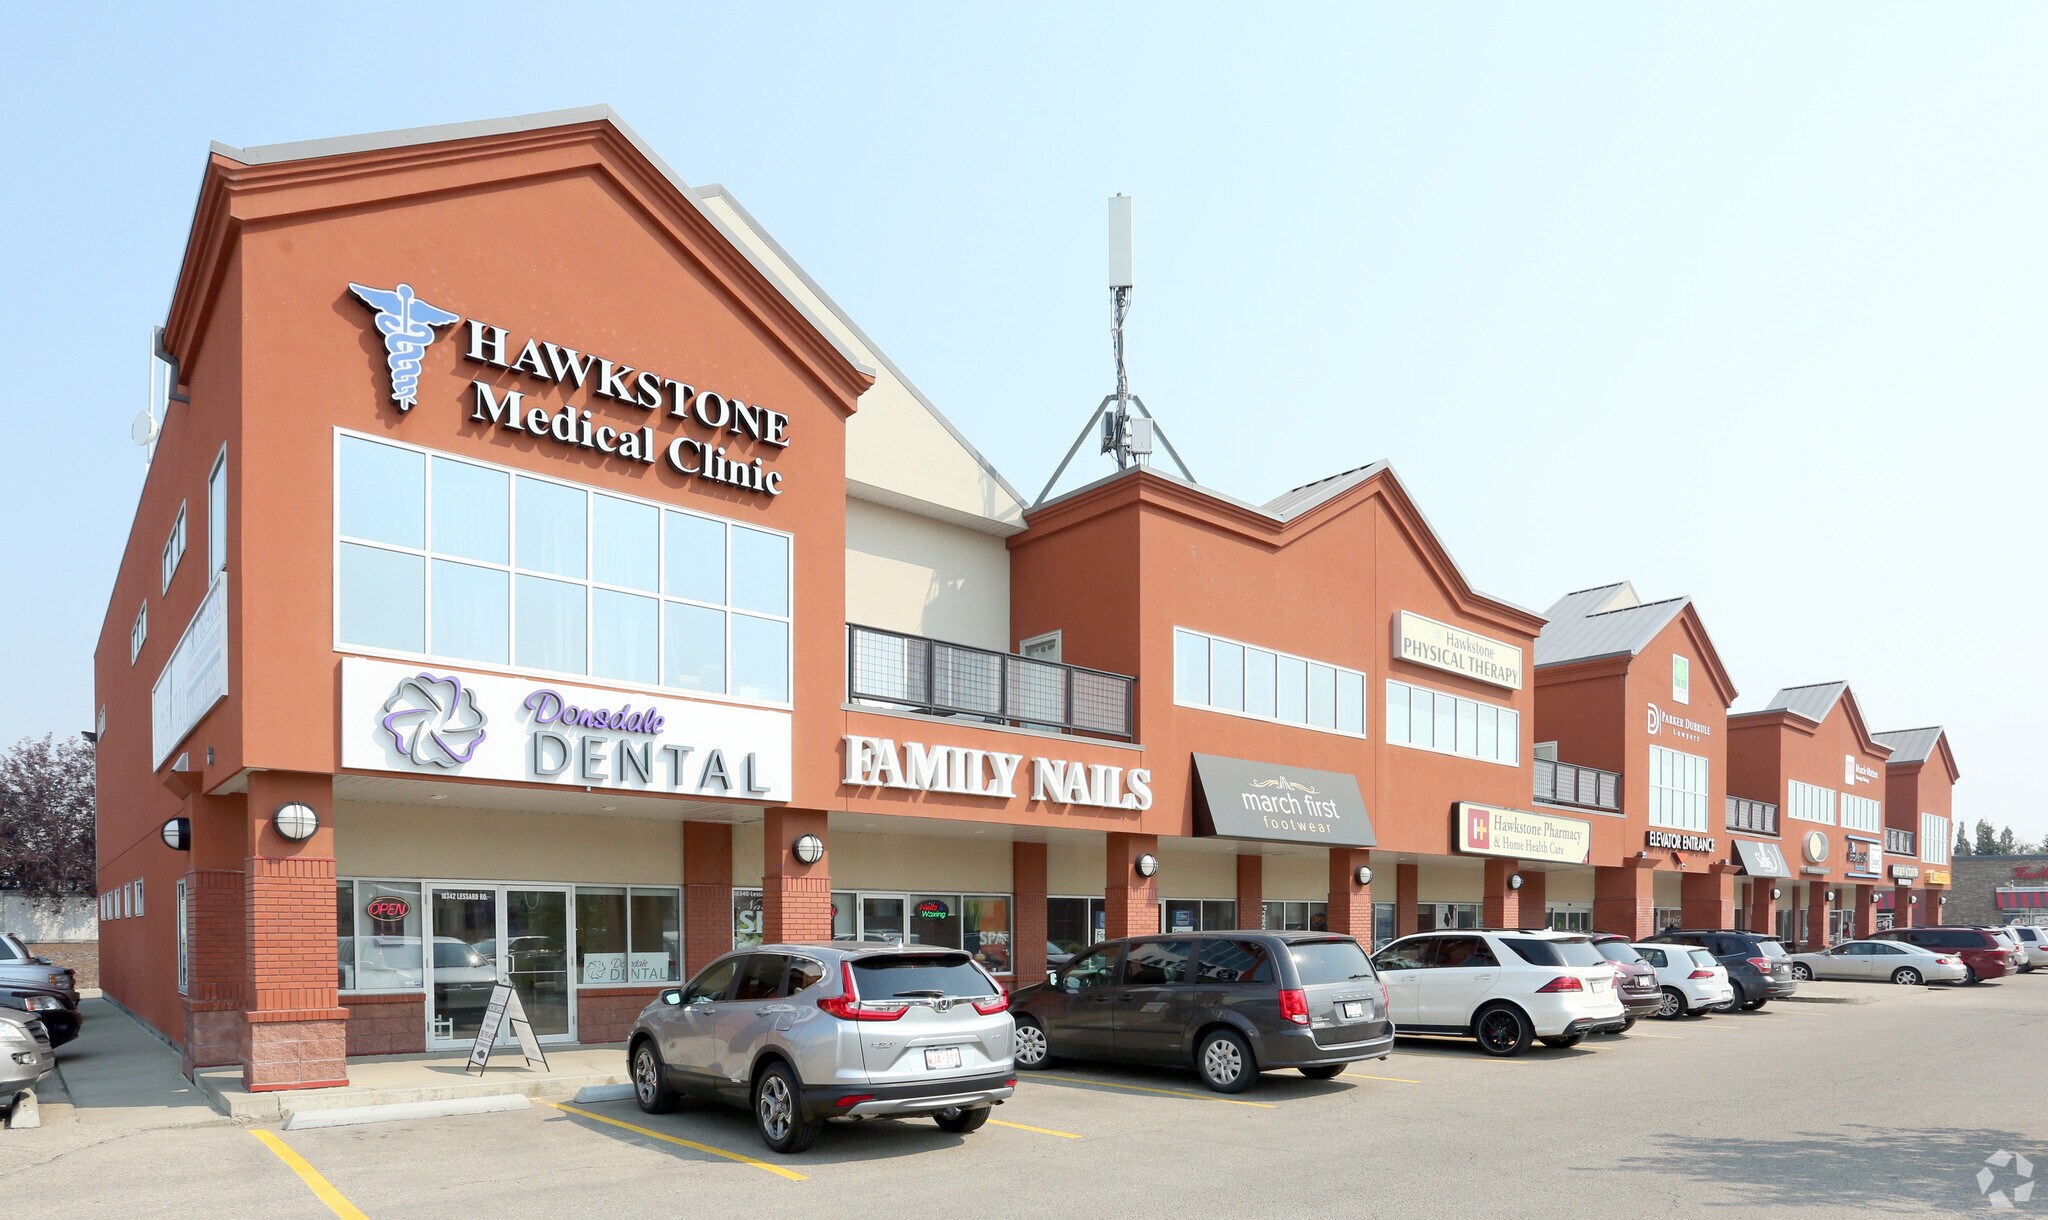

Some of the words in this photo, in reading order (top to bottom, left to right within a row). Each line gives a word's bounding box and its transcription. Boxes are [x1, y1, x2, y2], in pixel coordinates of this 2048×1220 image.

[466, 318, 790, 448] HAWKSTONE
[471, 380, 655, 464] Medical
[668, 436, 784, 496] Clinic
[1446, 631, 1495, 659] Hawkstone
[1404, 637, 1465, 669] PHYSICAL
[1468, 656, 1519, 684] THERAPY
[523, 689, 665, 734] Donsdale
[1661, 711, 1684, 728] PARKER
[1673, 728, 1700, 742] Lawyers
[534, 730, 771, 793] DENTAL
[841, 734, 1023, 798] FAMILY
[1031, 757, 1153, 811] NAILS
[1241, 792, 1302, 815] march
[1304, 795, 1341, 819] first
[1263, 815, 1332, 834] footwear
[1494, 815, 1541, 836] Hawkstone
[1543, 822, 1582, 845] Pharmacy
[1494, 836, 1501, 848] &
[1502, 837, 1525, 851] Home
[1526, 839, 1548, 854] Health
[1549, 841, 1565, 855] Care
[1649, 830, 1682, 849] ELEVATOR
[1682, 838, 1716, 853] ENTRANCE
[456, 892, 479, 900] LESSARD
[369, 902, 407, 916] OPEN
[921, 910, 947, 919] Waxing
[979, 931, 1006, 945] SPA
